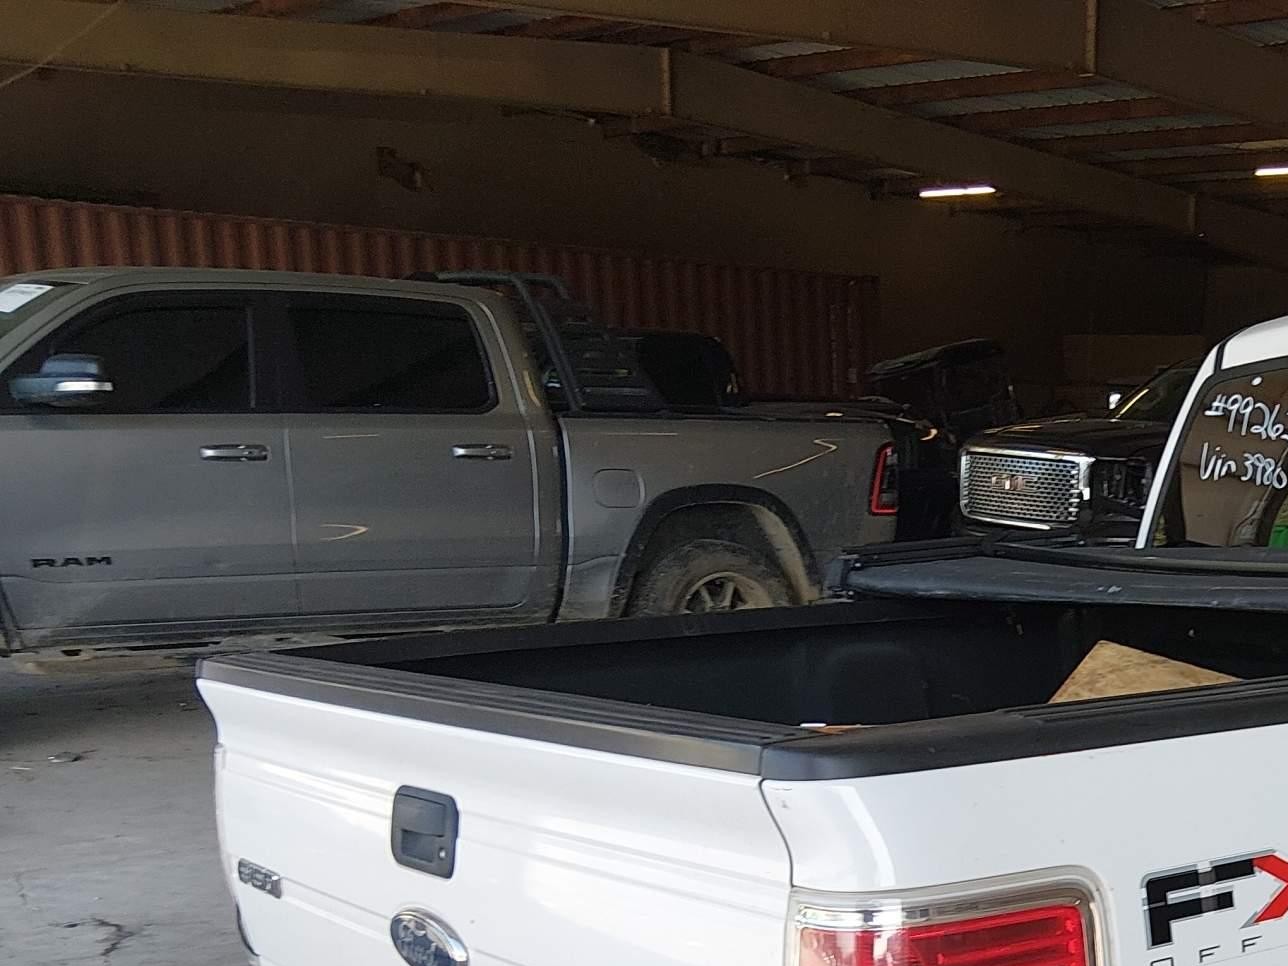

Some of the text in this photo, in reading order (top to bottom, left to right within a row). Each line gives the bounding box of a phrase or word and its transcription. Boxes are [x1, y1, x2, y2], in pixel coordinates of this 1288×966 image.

[1200, 442, 1288, 489] Vin 3980
[31, 556, 112, 568] RAM
